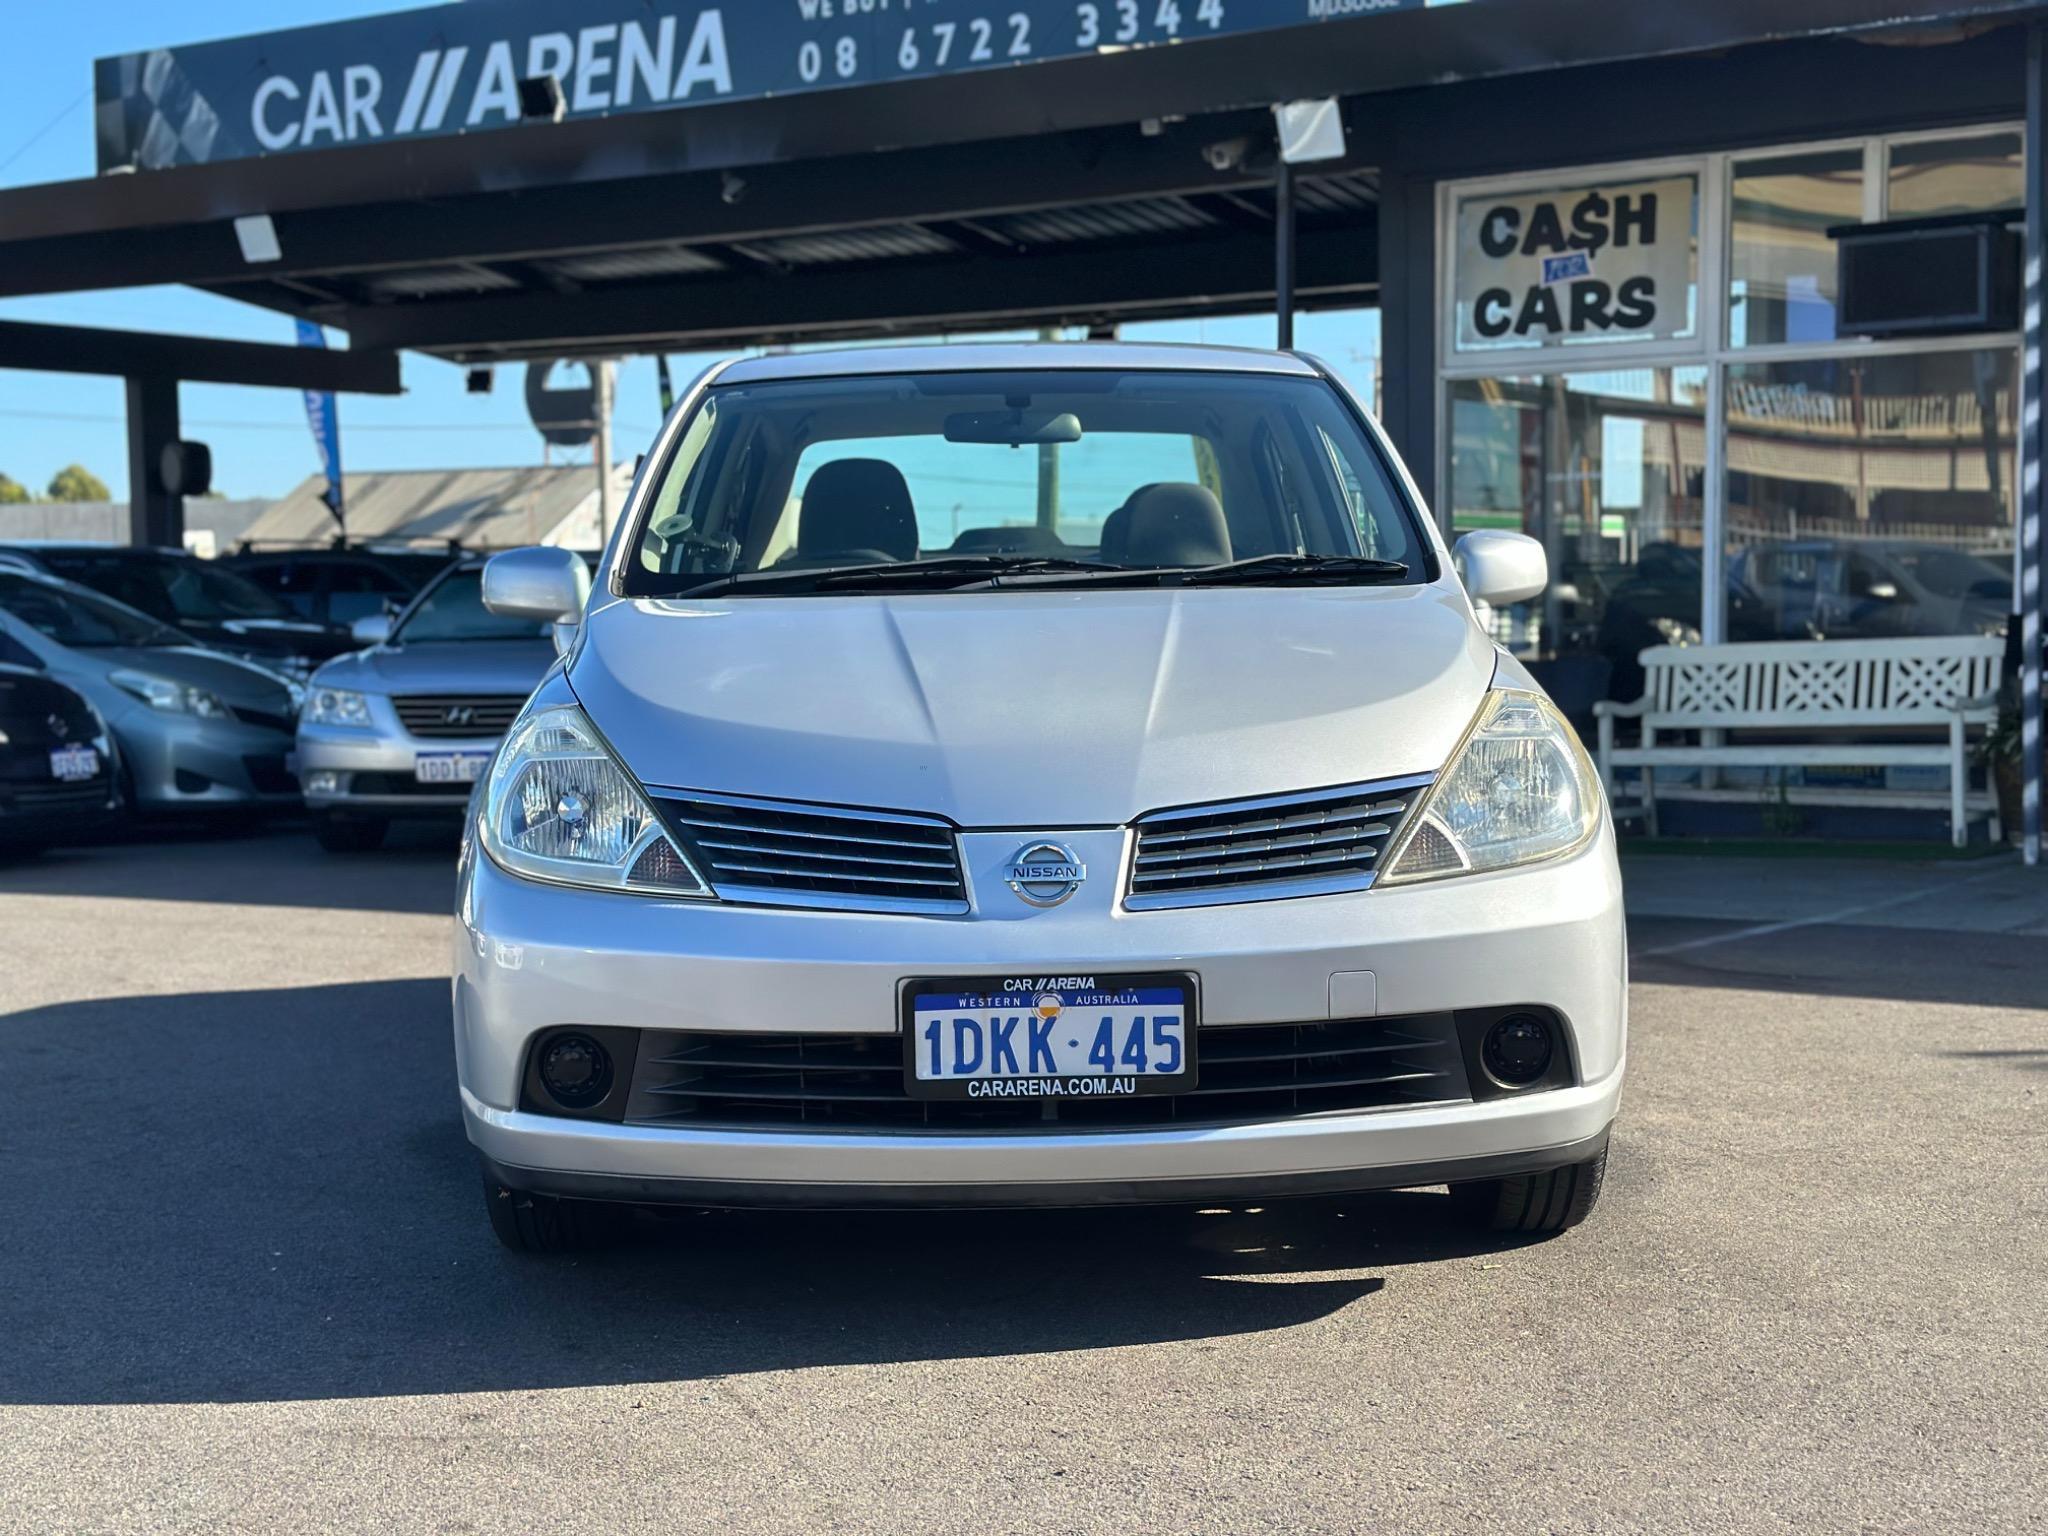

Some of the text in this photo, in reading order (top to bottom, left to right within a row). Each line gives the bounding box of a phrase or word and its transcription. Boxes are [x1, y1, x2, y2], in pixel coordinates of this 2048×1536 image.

[798, 0, 1225, 82] 08 6722 3344
[252, 65, 383, 150] CAR
[1480, 192, 1656, 258] CA$H
[1474, 276, 1656, 337] CARS
[1013, 867, 1077, 878] NISSAN
[959, 995, 1139, 1007] WESTERN AUSTRALIA
[1004, 978, 1032, 991] CAR
[1047, 977, 1095, 990] ARENA
[967, 1078, 1136, 1097] CARARENA.COM.AU
